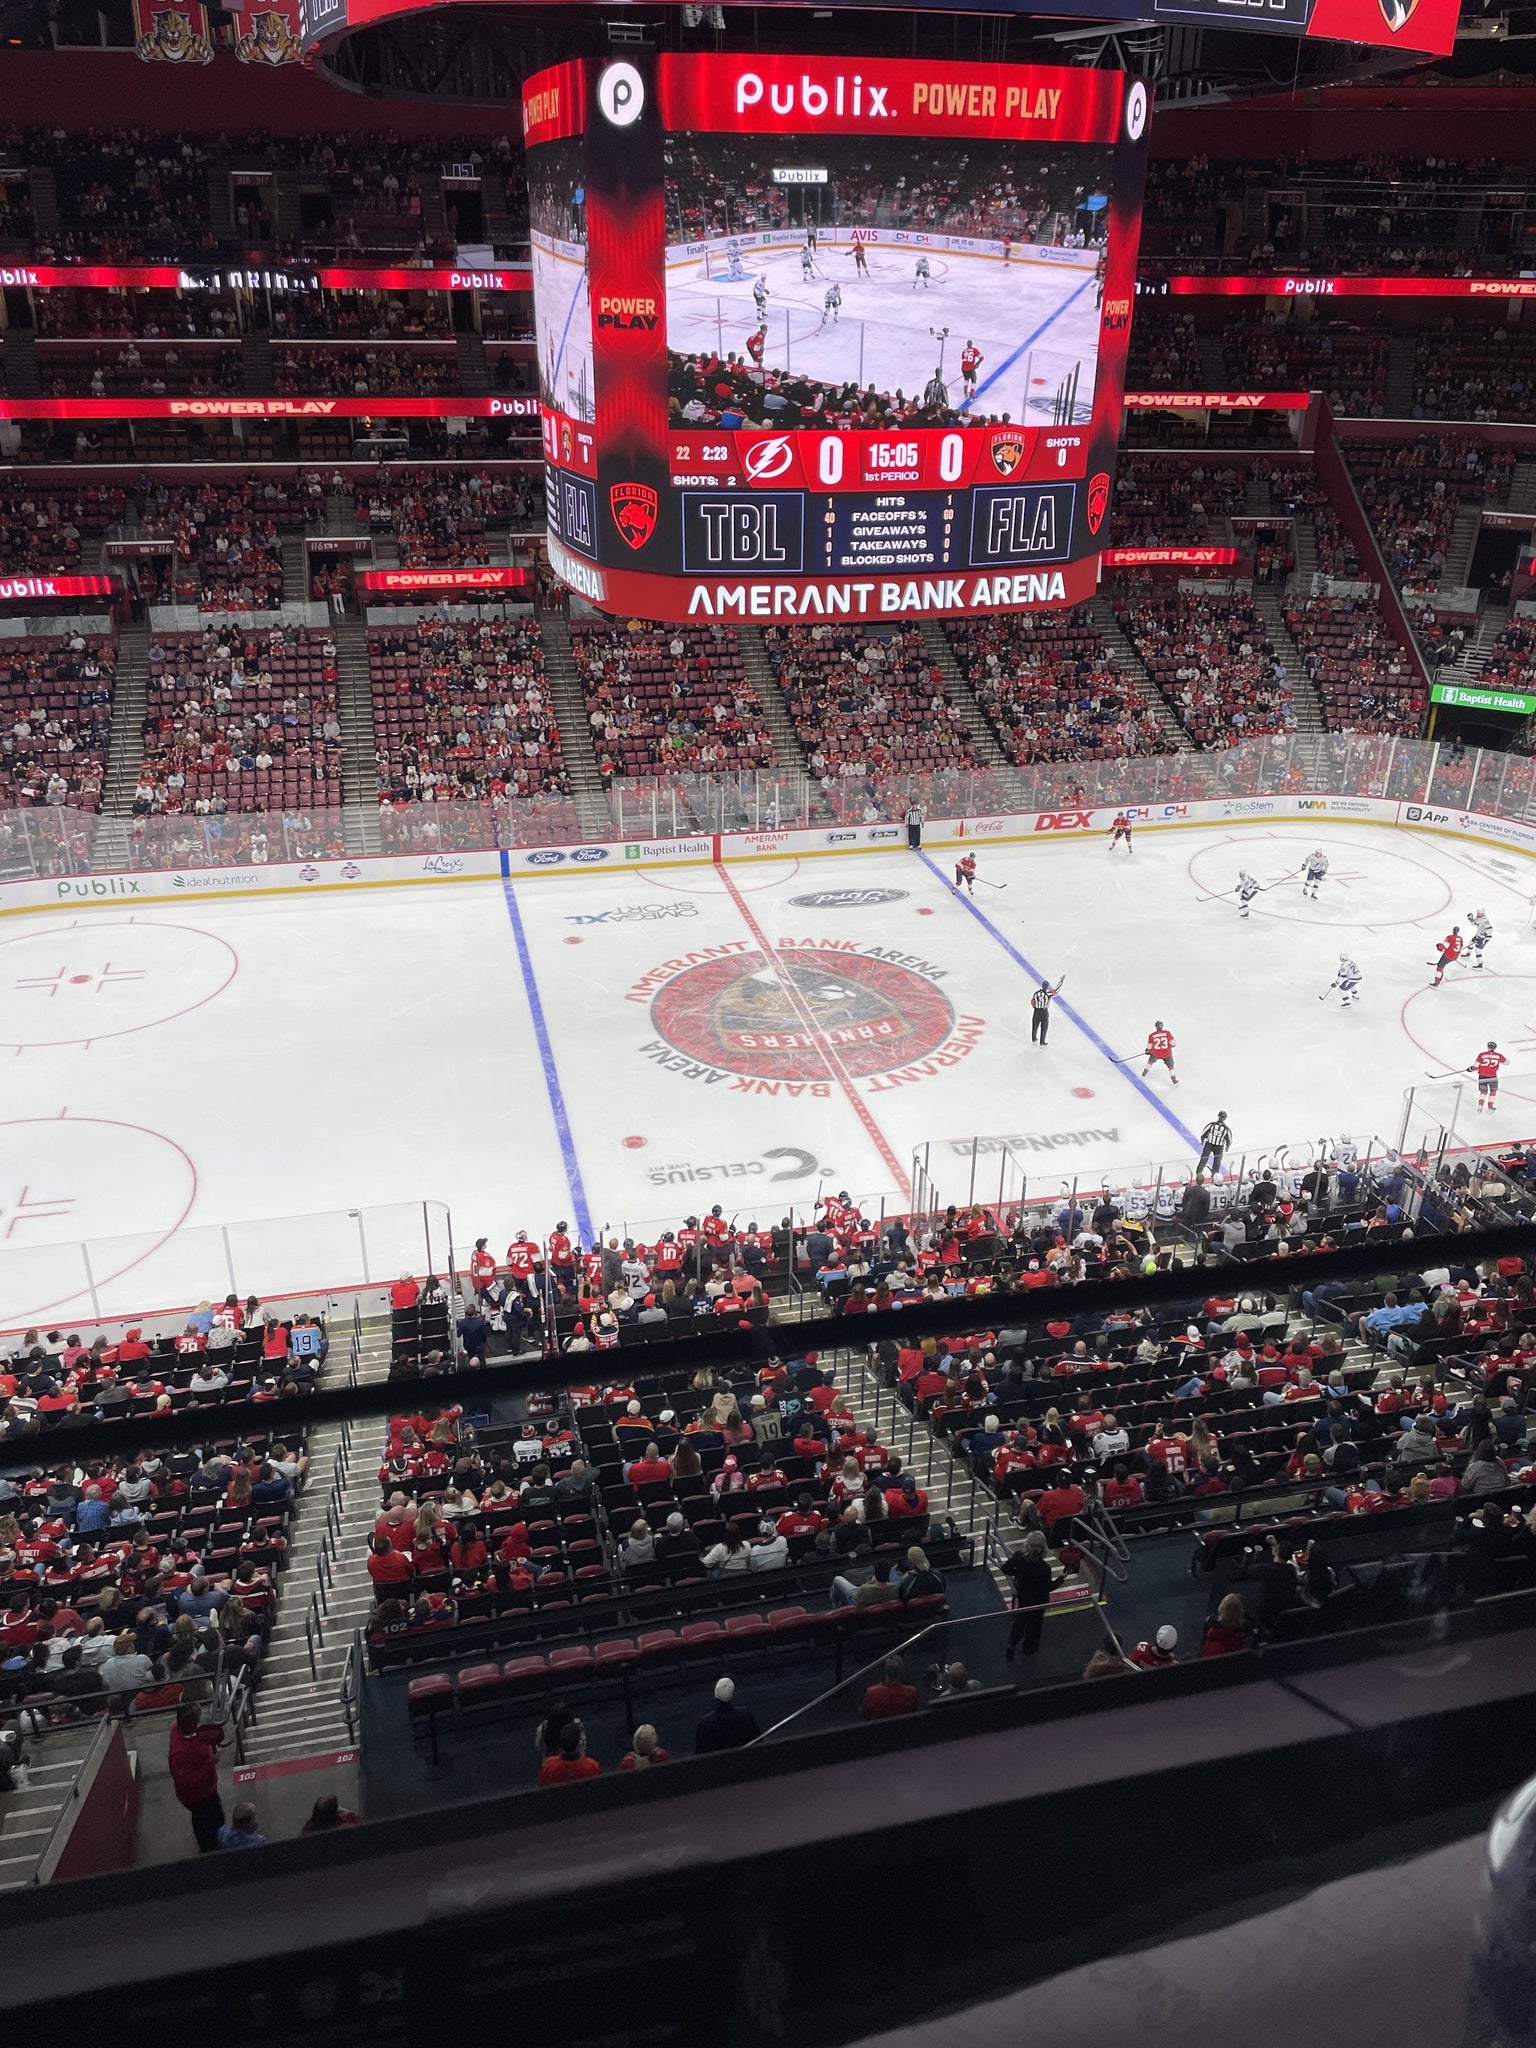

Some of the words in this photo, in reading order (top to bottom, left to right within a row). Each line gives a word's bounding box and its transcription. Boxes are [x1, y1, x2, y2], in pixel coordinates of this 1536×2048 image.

[544, 88, 559, 120] PLAY
[913, 82, 996, 117] POWER
[1005, 87, 1062, 119] PLAY
[779, 170, 819, 182] Publix
[850, 230, 878, 241] AVIS
[0, 269, 38, 285] blix
[451, 273, 504, 288] Publix
[1285, 280, 1334, 294] Publix
[1470, 283, 1536, 294] POWE
[600, 298, 655, 315] POWER
[1105, 300, 1129, 315] POWER
[598, 314, 659, 330] PLAY
[1103, 316, 1129, 330] PLAY
[170, 402, 271, 414] POWER
[273, 402, 336, 414] PLAY
[1124, 395, 1203, 407] POWER
[1205, 395, 1264, 407] PLAY
[1046, 437, 1081, 447] SHOTS
[676, 446, 690, 460] 22
[703, 446, 728, 460] 2:23
[820, 436, 843, 484] 0
[869, 443, 918, 467] 15:05
[940, 434, 964, 481] 0
[1057, 448, 1067, 467] 0
[674, 476, 719, 486] SHOTS:
[728, 477, 736, 486] 2
[864, 472, 879, 481] 1st
[880, 472, 919, 481] PERIOD
[614, 486, 654, 500] FLORIDA
[828, 497, 833, 509] 1
[876, 497, 905, 507] HITS
[947, 494, 953, 506] 1
[565, 482, 591, 546] FLA
[825, 512, 835, 523] 40
[852, 511, 916, 522] FACEOFFS
[918, 510, 927, 520] %
[827, 527, 832, 538] 1
[853, 525, 926, 536] GIVEAWAYS
[945, 523, 951, 534] 0
[988, 495, 1056, 554] FLA
[701, 504, 786, 560] TBL
[311, 541, 323, 550] 116
[355, 541, 367, 550] 117
[515, 538, 525, 546] 117
[826, 541, 832, 552] 0
[851, 539, 927, 551] TAKEAWAYS
[944, 538, 950, 549] 0
[111, 546, 124, 554] 115
[158, 545, 171, 553] 116
[1114, 551, 1170, 562] POWER
[1171, 551, 1216, 562] PLAY
[827, 556, 832, 567] 1
[841, 555, 894, 565] BLOCKED
[896, 553, 934, 564] SHOTS
[943, 552, 949, 563] 0
[386, 575, 453, 586] POWER
[455, 572, 504, 584] PLAY
[566, 563, 605, 601] ARENA
[688, 583, 875, 615] AMERANT
[881, 578, 966, 612] BANK
[970, 572, 1066, 607] ARENA
[1459, 693, 1492, 706] Baptist
[1494, 696, 1526, 709] Health
[1164, 805, 1187, 816] CH
[1235, 801, 1274, 811] BioStem
[1298, 800, 1327, 809] WM
[1126, 808, 1149, 819] CH
[1034, 811, 1095, 831] DEX
[745, 833, 790, 844] AMERANT
[1479, 822, 1502, 832] CENTERS
[1513, 830, 1535, 841] FLORIDA
[577, 849, 602, 860] Ford
[643, 845, 677, 857] Baptist
[679, 842, 710, 853] Health
[757, 844, 777, 852] BANK
[534, 852, 559, 863] Ford
[57, 878, 141, 897] Publix
[187, 874, 258, 888] idealnutrition
[616, 902, 694, 914] SPORT
[564, 911, 612, 924] XL
[608, 909, 698, 922] OMEGA
[624, 941, 748, 1003] AMERANT
[779, 937, 862, 953] BANK
[863, 946, 950, 982] ARENA
[739, 1020, 893, 1049] PANTHERS
[1153, 1037, 1168, 1050] 23
[868, 1015, 987, 1093] AMERANT
[638, 1040, 731, 1085] ARENA
[730, 1077, 831, 1098] BANK
[952, 1127, 1121, 1156] AutoNation
[649, 1163, 665, 1172] FIT
[649, 1161, 765, 1186] CELSIUS
[668, 1163, 691, 1171] LIVE
[1131, 1197, 1147, 1210] 53
[1213, 1196, 1227, 1209] 19
[511, 1253, 528, 1268] 72
[663, 1248, 677, 1261] 10
[295, 1334, 312, 1352] 19
[762, 1421, 779, 1440] 19
[1111, 1498, 1130, 1507] 101
[383, 1622, 409, 1634] 102
[337, 1754, 353, 1763] 102
[239, 1772, 256, 1782] 103
